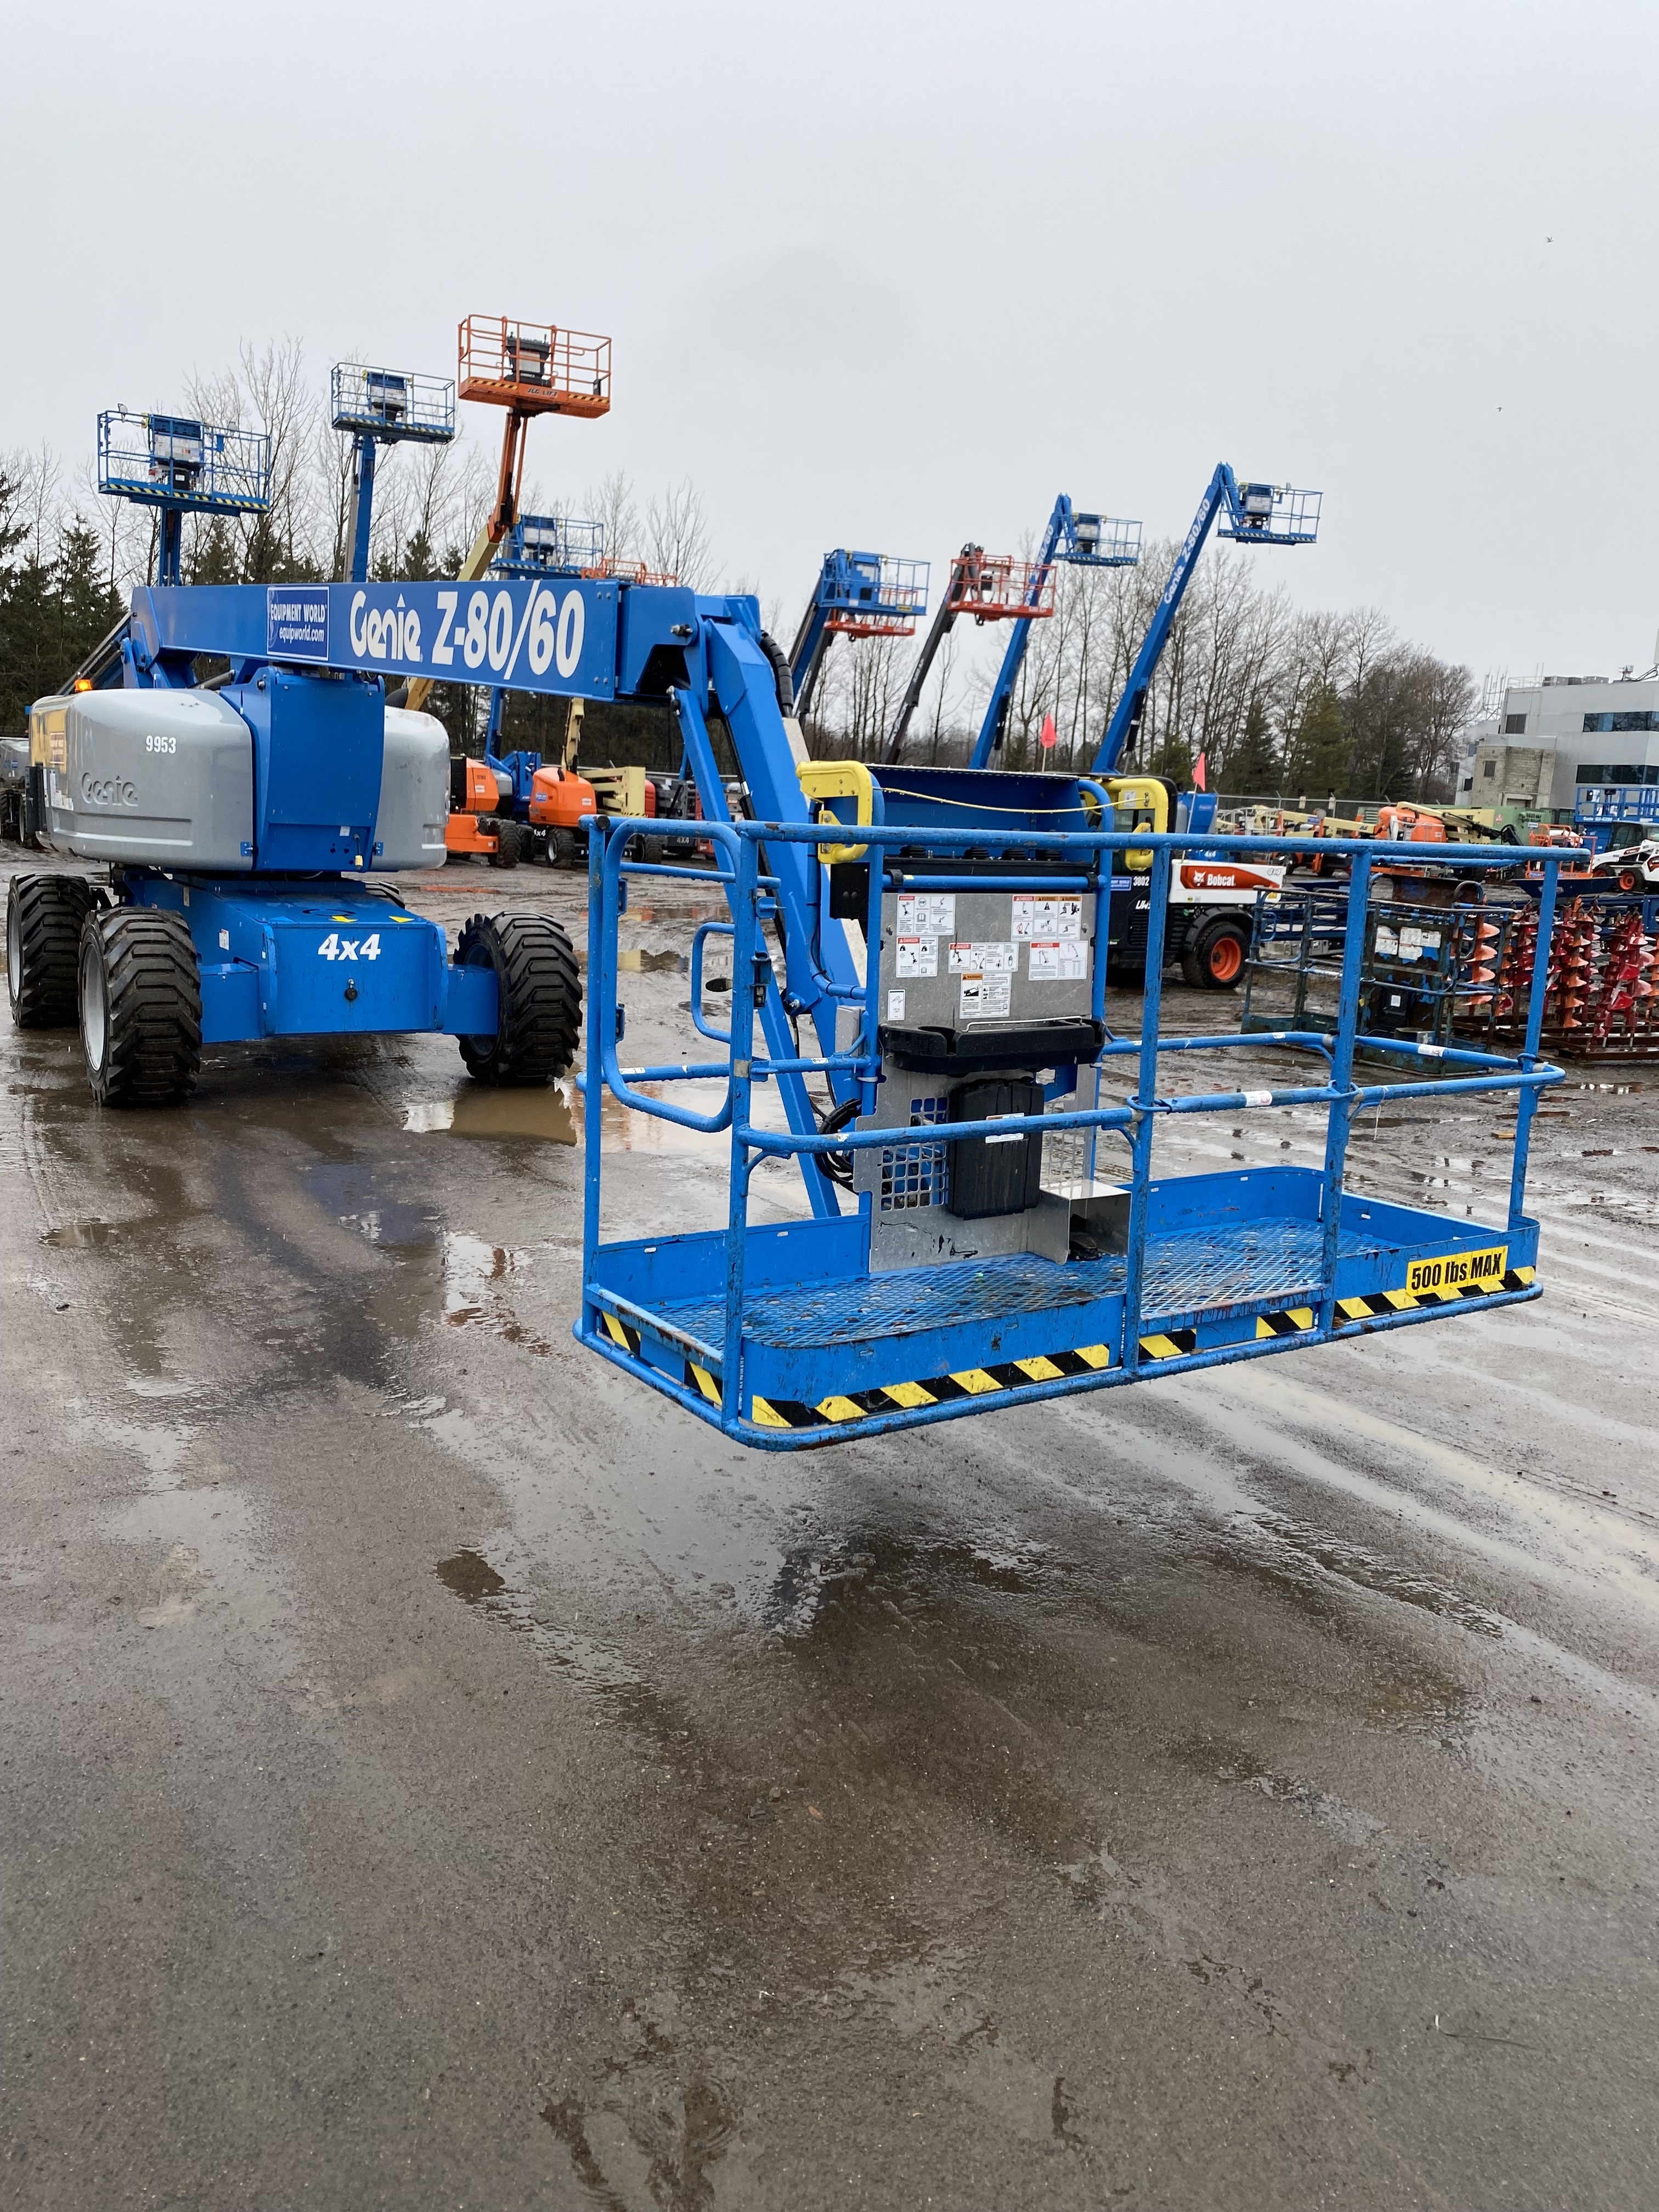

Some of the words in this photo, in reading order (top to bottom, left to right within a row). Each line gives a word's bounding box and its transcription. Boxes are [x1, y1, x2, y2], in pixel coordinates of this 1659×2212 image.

[1164, 565, 1185, 604] Genie
[1182, 498, 1210, 562] Z-80/60
[270, 603, 302, 622] EQUIPMENT
[303, 605, 326, 623] WORLD
[279, 623, 325, 644] equipworld.com
[349, 590, 421, 662] Genie
[431, 580, 585, 680] Z-80/60
[145, 735, 177, 754] 9953
[81, 772, 139, 806] Genie
[1133, 876, 1150, 887] 3802
[1207, 873, 1235, 887] Bobcat
[318, 934, 381, 960] 4x4
[1412, 1264, 1442, 1290] 500
[1444, 1261, 1468, 1284] lbs
[1470, 1253, 1502, 1279] MAX
